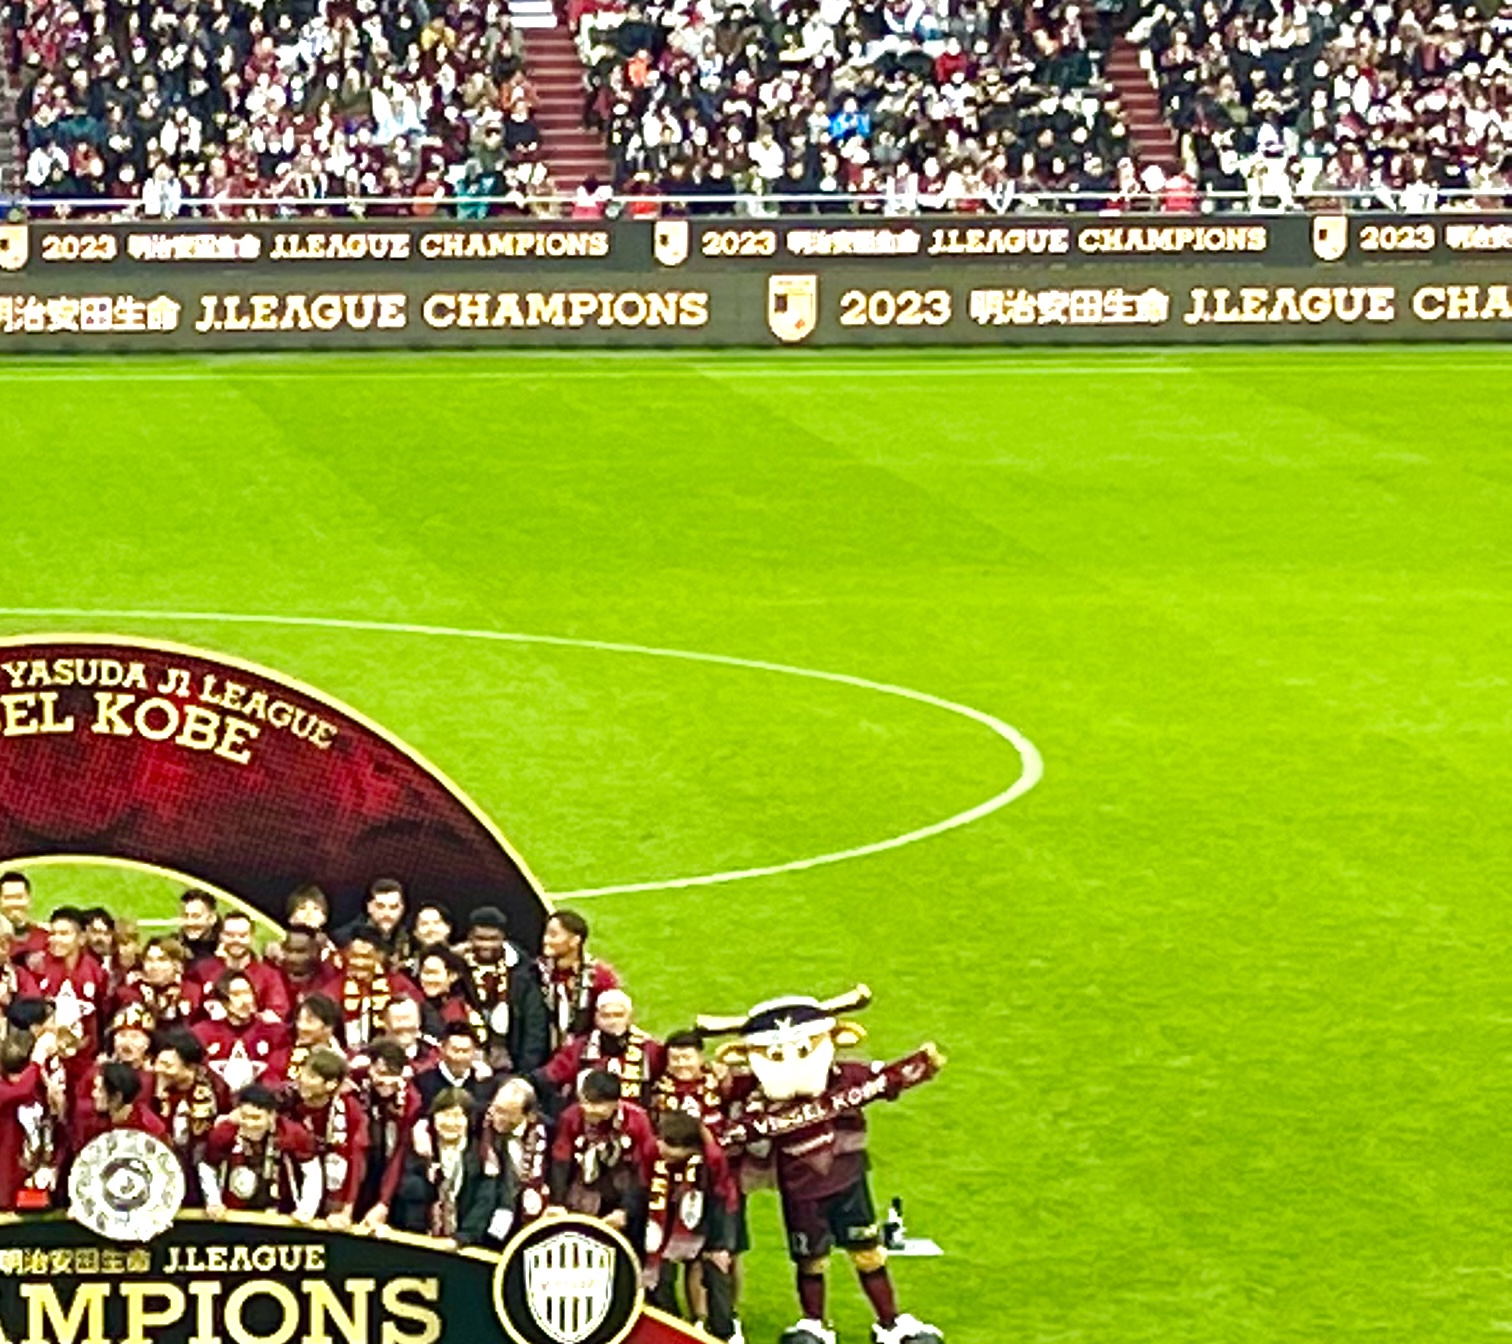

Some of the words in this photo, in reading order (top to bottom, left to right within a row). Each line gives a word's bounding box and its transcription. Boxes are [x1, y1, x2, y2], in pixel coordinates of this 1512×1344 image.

[42, 235, 117, 260] 2023
[269, 233, 410, 259] J.LEAGUE
[420, 232, 609, 258] CHAMPIONS
[702, 230, 776, 255] 2023
[929, 229, 1068, 254] J.LEAGUE
[1078, 226, 1267, 252] CHAMPIONS
[1359, 224, 1435, 250] 2023
[195, 294, 406, 332] J.LEAGUE
[423, 292, 708, 327] CHAMPIONS
[840, 290, 951, 325] 2023
[970, 288, 1169, 325] 明治安田生命
[1184, 287, 1395, 324] J.LEAGUE
[0, 658, 148, 688] YASUDA
[198, 673, 340, 750] LEAGUE
[92, 691, 260, 765] KOBE
[162, 1244, 326, 1274] J.LEAGUE
